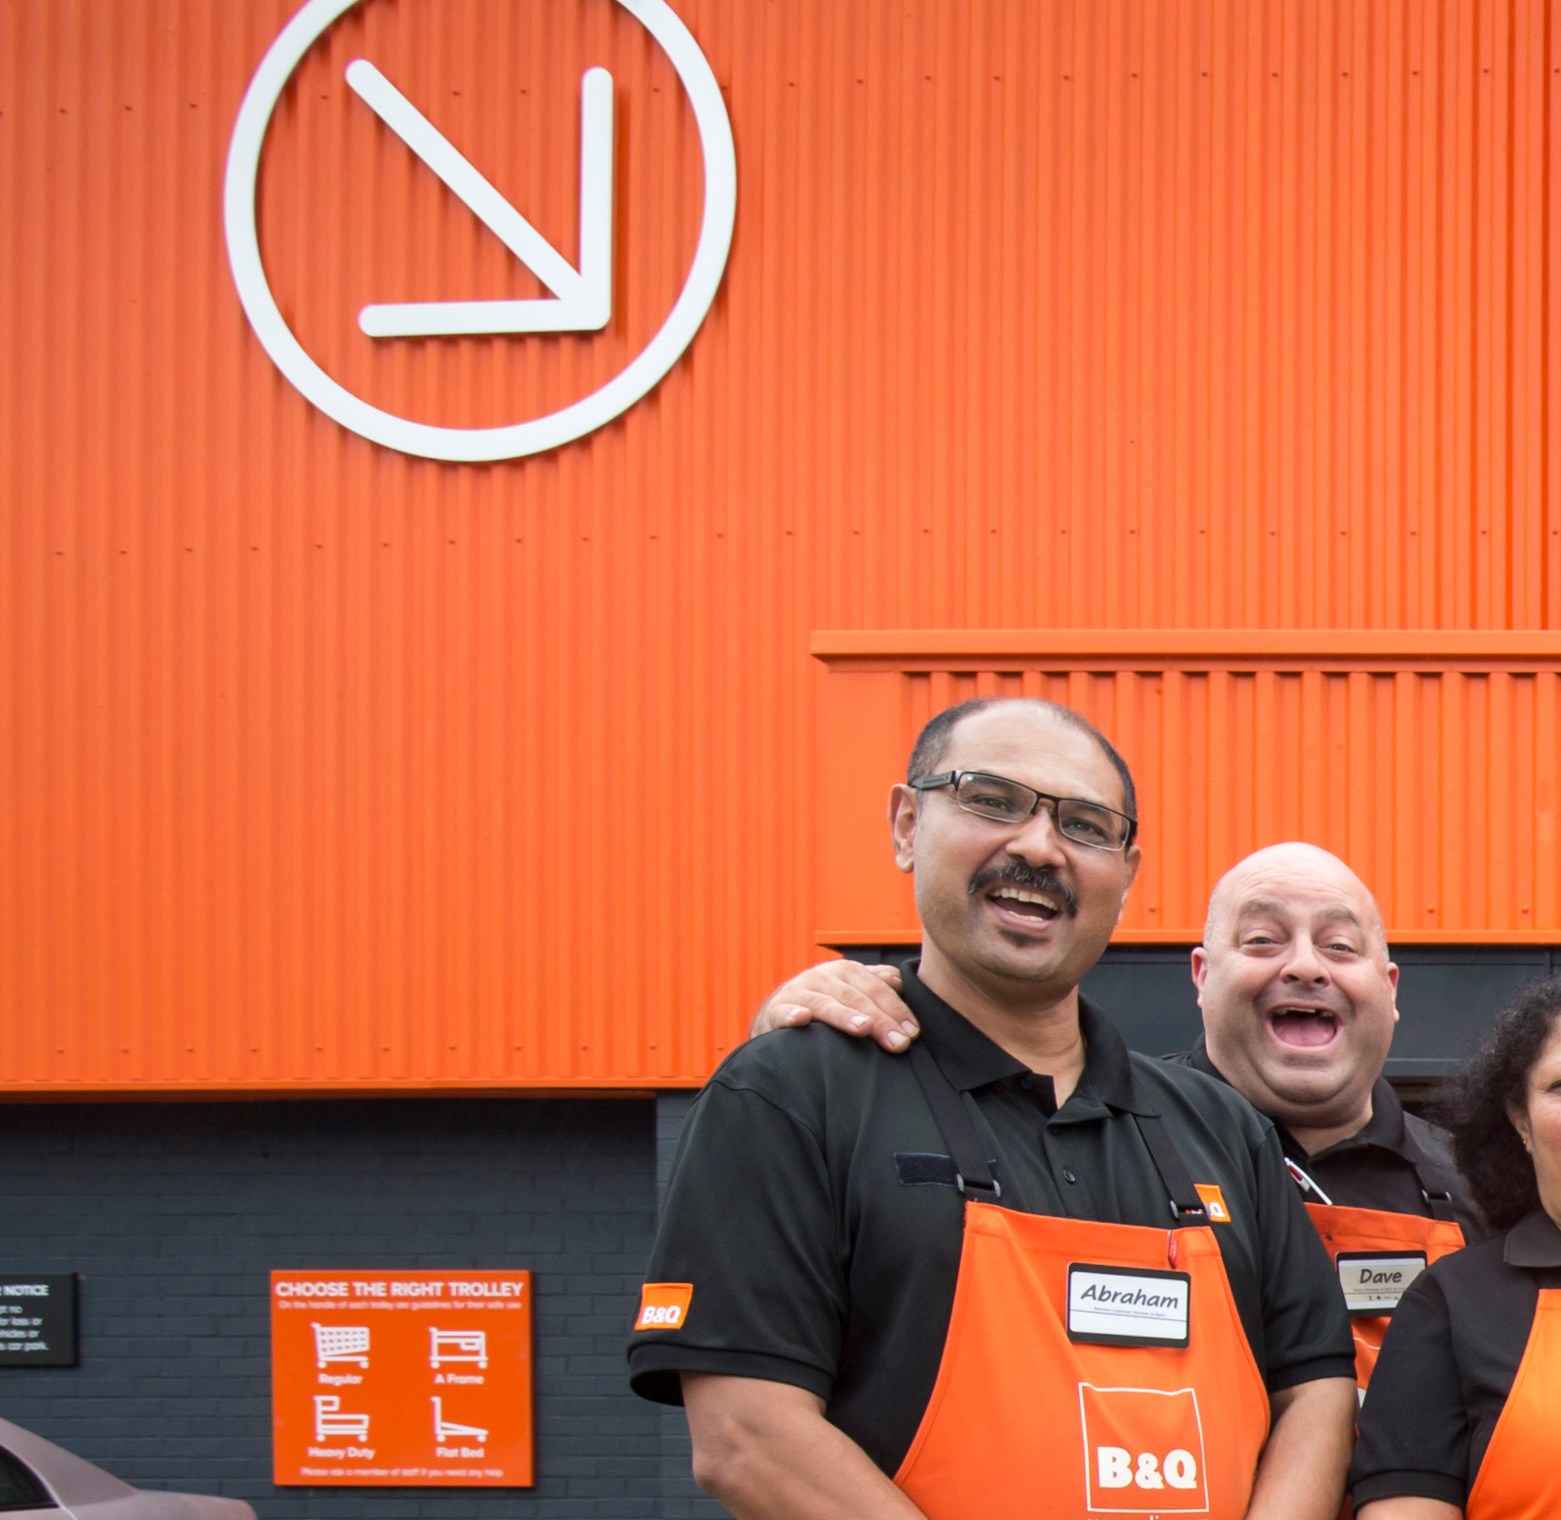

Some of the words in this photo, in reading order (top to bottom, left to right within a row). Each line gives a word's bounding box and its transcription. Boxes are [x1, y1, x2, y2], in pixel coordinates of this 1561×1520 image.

[1359, 1268, 1403, 1284] Dave
[3, 1284, 50, 1296] NOTICE
[275, 1281, 350, 1297] CHOOSE
[352, 1281, 387, 1297] THE
[390, 1281, 445, 1297] RIGHT
[448, 1281, 524, 1297] TROLLEY
[1080, 1283, 1179, 1310] Abraham
[641, 1305, 682, 1325] B&Q
[318, 1373, 363, 1387] Regular
[434, 1373, 446, 1384] A
[446, 1373, 485, 1384] Frame
[307, 1446, 345, 1460] Heavy
[346, 1446, 376, 1460] Duty
[436, 1446, 459, 1458] Flat
[460, 1446, 485, 1458] Bed
[1096, 1446, 1198, 1489] B&Q
